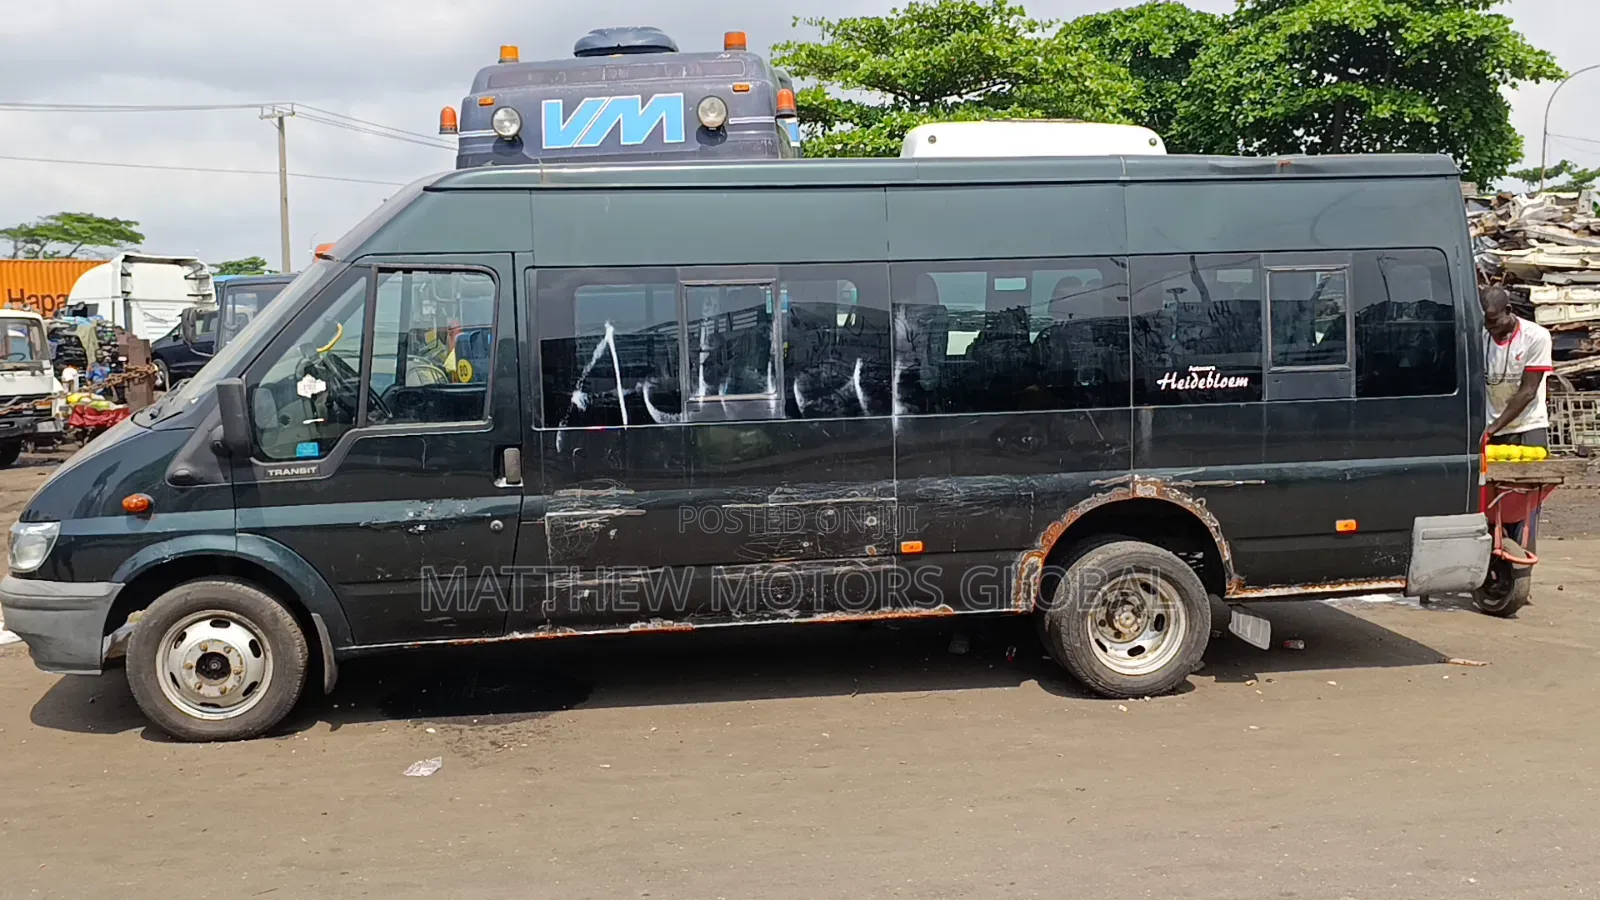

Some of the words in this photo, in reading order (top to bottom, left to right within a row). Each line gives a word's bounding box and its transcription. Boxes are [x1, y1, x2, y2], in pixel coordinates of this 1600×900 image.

[542, 93, 685, 149] VM
[1156, 371, 1249, 391] Heidebloem
[267, 465, 318, 476] TRANSIT
